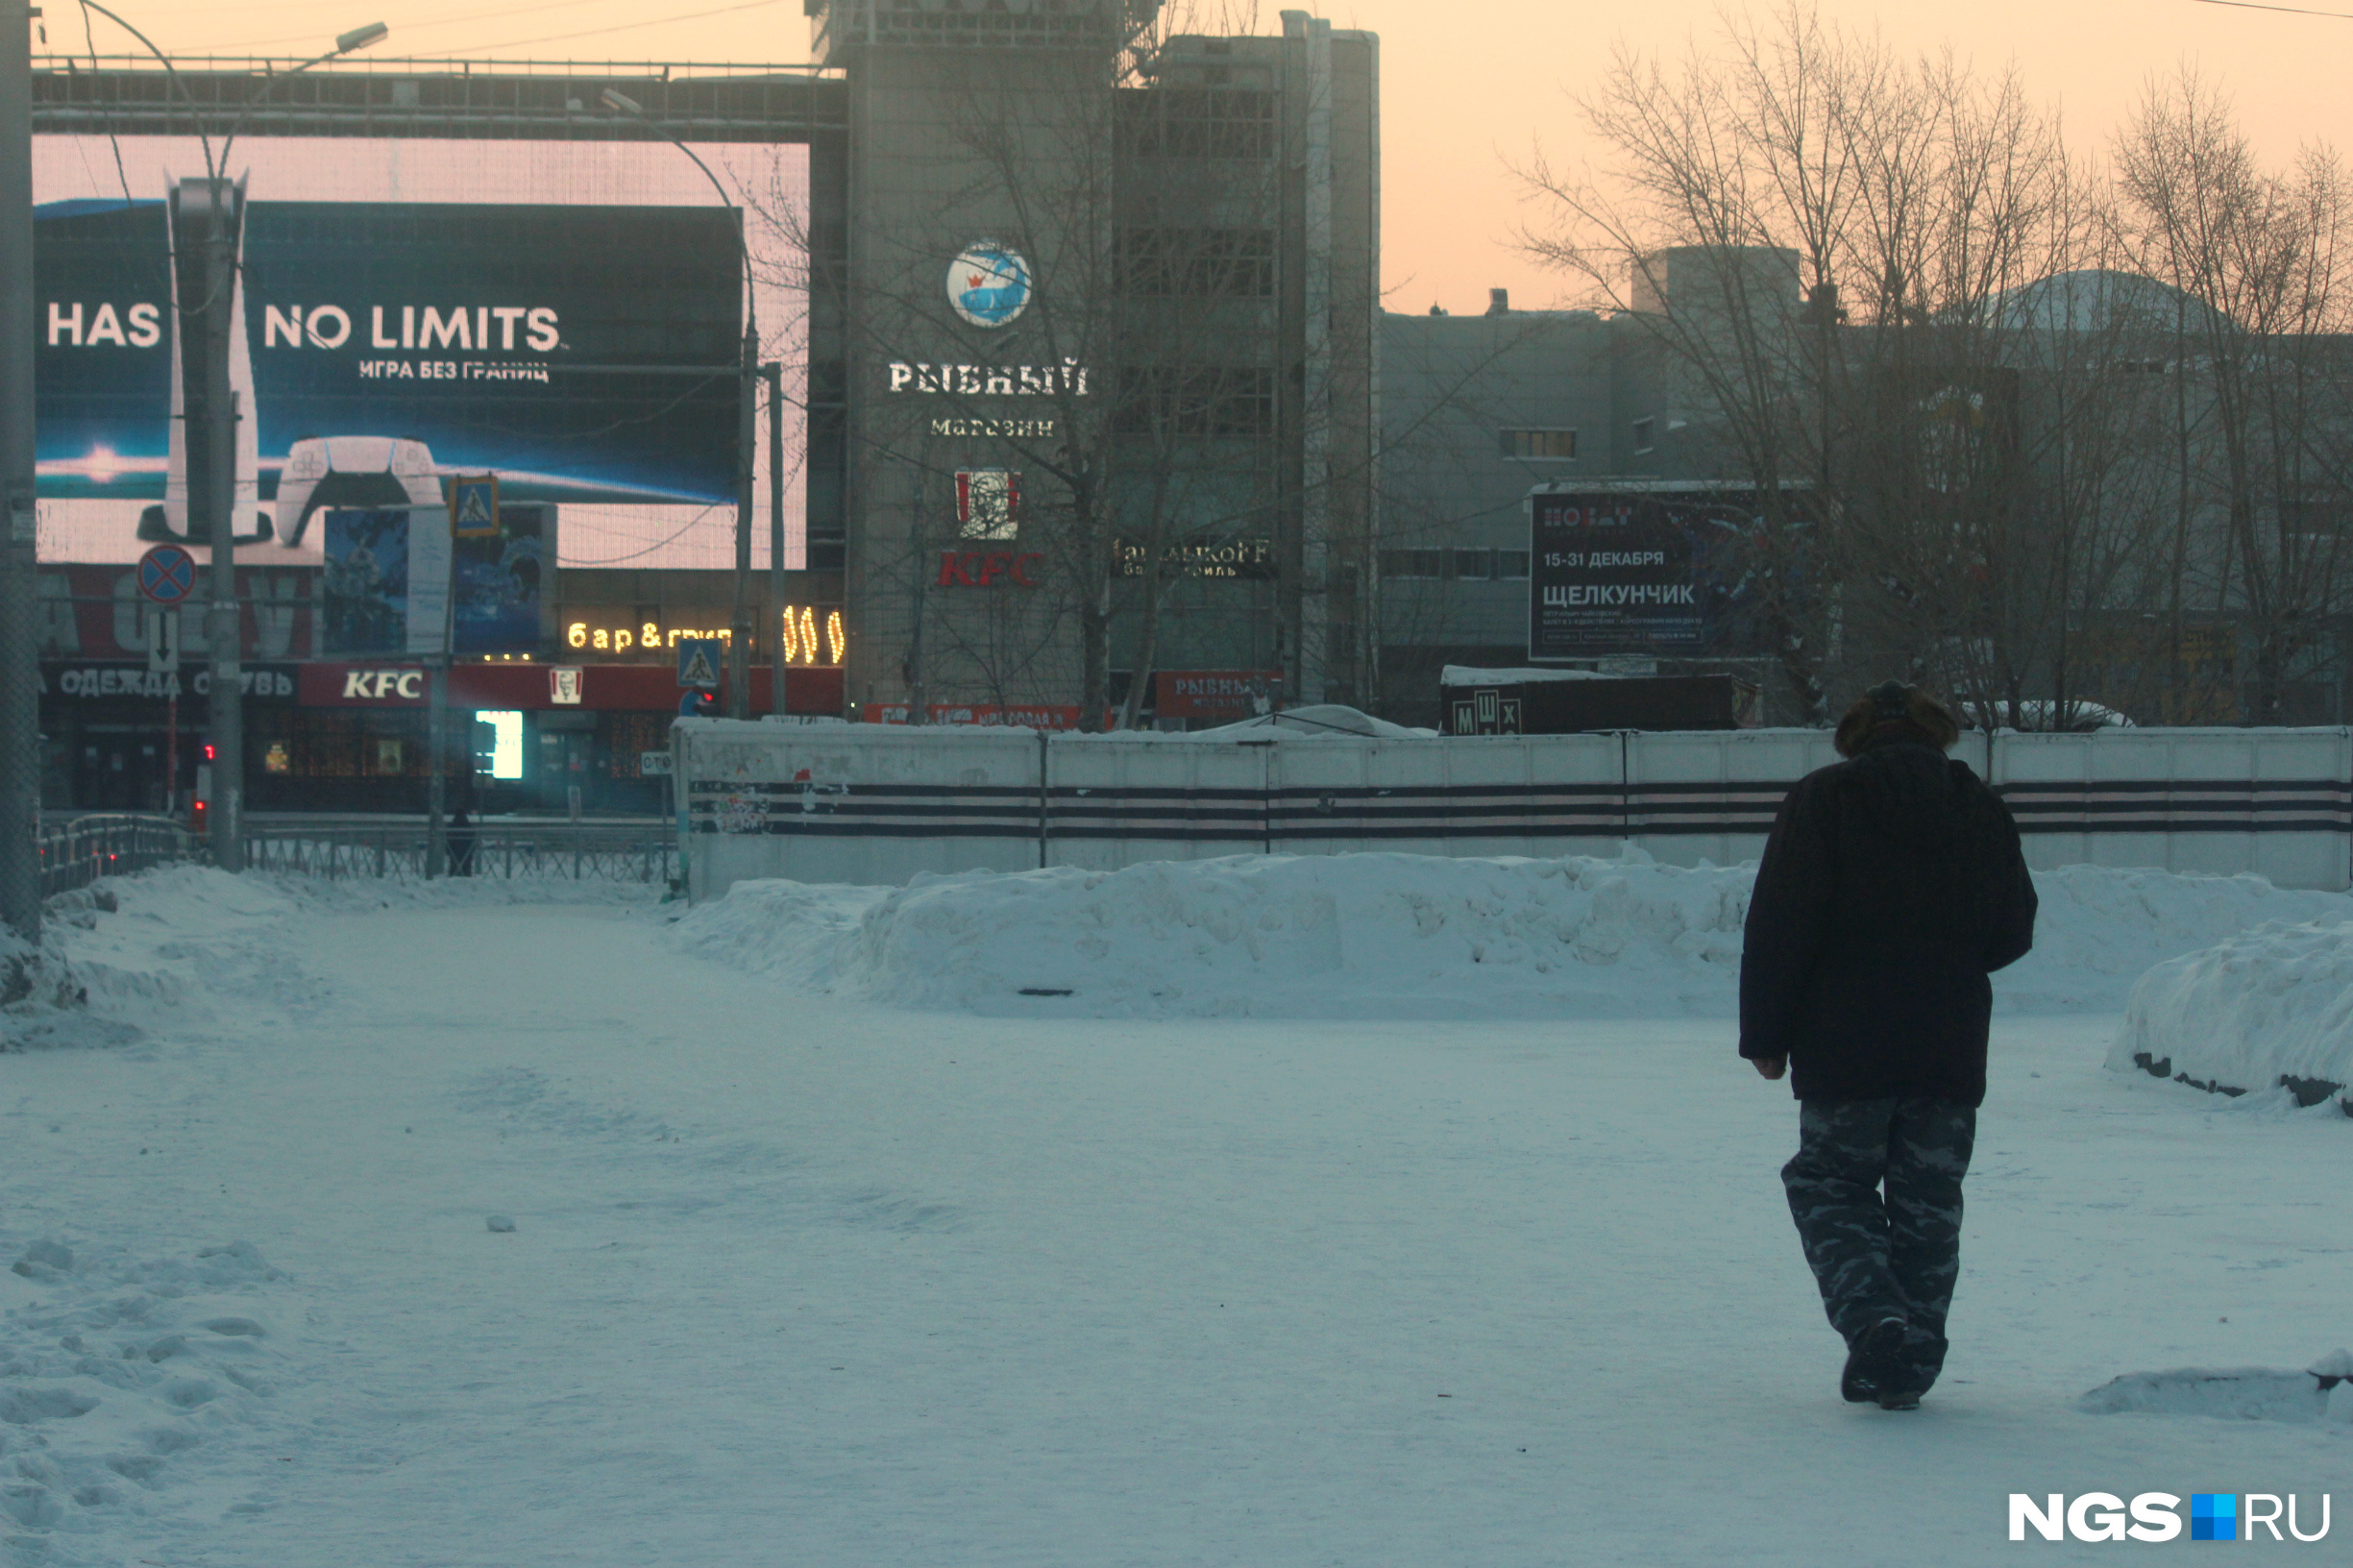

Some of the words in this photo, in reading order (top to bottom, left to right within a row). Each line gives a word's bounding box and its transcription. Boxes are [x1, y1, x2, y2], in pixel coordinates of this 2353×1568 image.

[48, 302, 160, 348] HAS
[265, 305, 352, 350] NO
[372, 306, 560, 352] LIMITS
[359, 360, 414, 379] ИГРА
[420, 360, 457, 379] БЕЗ
[889, 356, 1090, 395] РЫБНЫЙ
[935, 551, 1043, 586] KFC
[1544, 552, 1584, 567] 15-31
[1588, 551, 1664, 568] ДЕКАБРЯ
[1543, 584, 1695, 607] ЩЕЛКУНЧИК
[568, 622, 632, 652] бар
[641, 622, 661, 648] &
[61, 669, 182, 697] ОДЕЖДА
[342, 671, 424, 700] KFC
